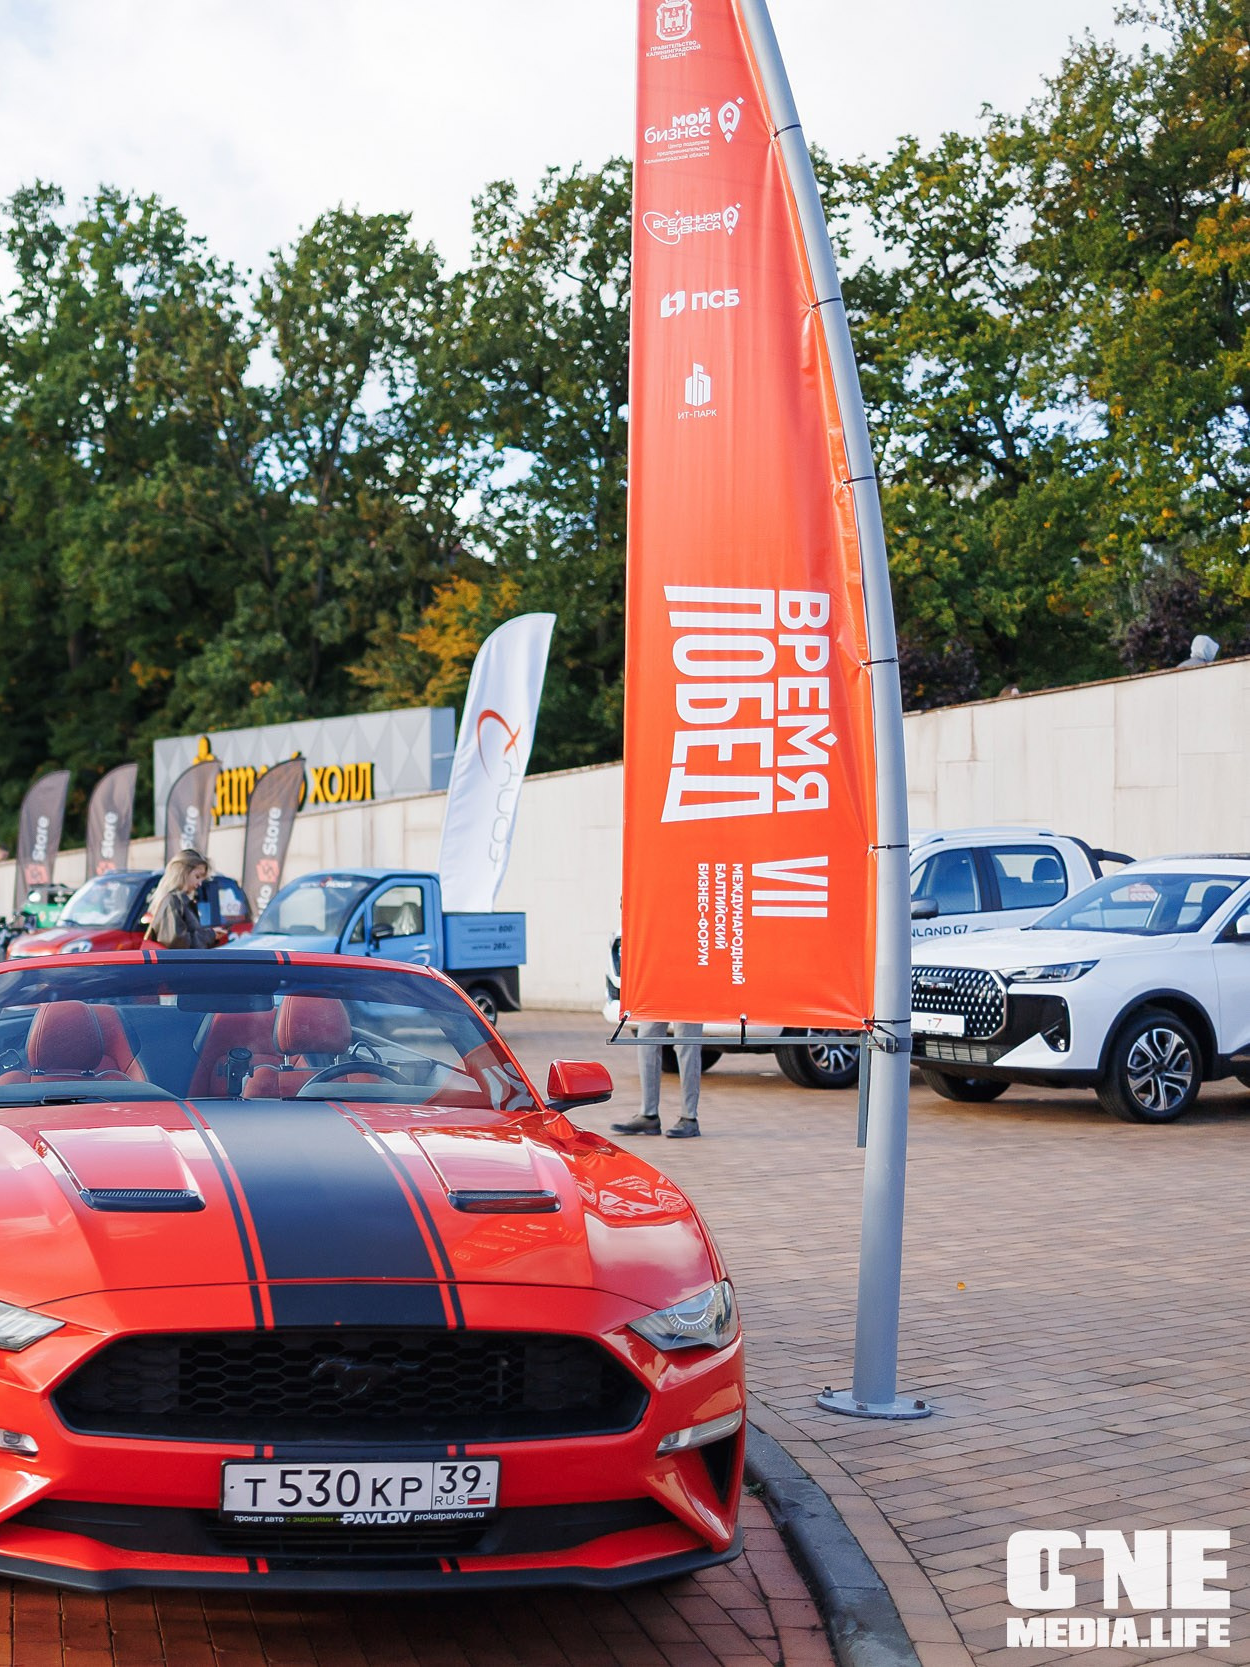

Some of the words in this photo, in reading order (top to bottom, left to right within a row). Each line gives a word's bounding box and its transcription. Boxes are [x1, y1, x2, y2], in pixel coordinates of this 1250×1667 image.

[644, 124, 711, 144] бизнес
[672, 107, 710, 128] мой
[653, 212, 721, 229] ВСЕЛЕННАЯ
[667, 221, 721, 236] БИЗНЕСА
[691, 289, 740, 311] ПСБ
[677, 409, 717, 420] ИТ-ПАРК
[661, 585, 776, 823] ПОБЕД
[777, 590, 837, 813] ВРЕМЯ
[309, 762, 375, 805] ХОЛЛ
[32, 815, 50, 861] Store
[100, 811, 119, 859] Store
[262, 806, 282, 856] Store
[752, 856, 829, 918] VII
[697, 863, 709, 966] БИЗНЕС-ФОРУМ
[715, 863, 729, 950] БАЛТИЙСКИЙ
[730, 863, 745, 985] МЕЖДУНАРОДНЫЙ
[911, 926, 951, 938] NLAND
[953, 924, 968, 934] G7
[438, 1465, 482, 1495] 39
[234, 1515, 263, 1523] прокат
[342, 1512, 411, 1525] PAVLOV
[414, 1511, 485, 1522] prokatpavlova.ru
[434, 1494, 466, 1507] RUS
